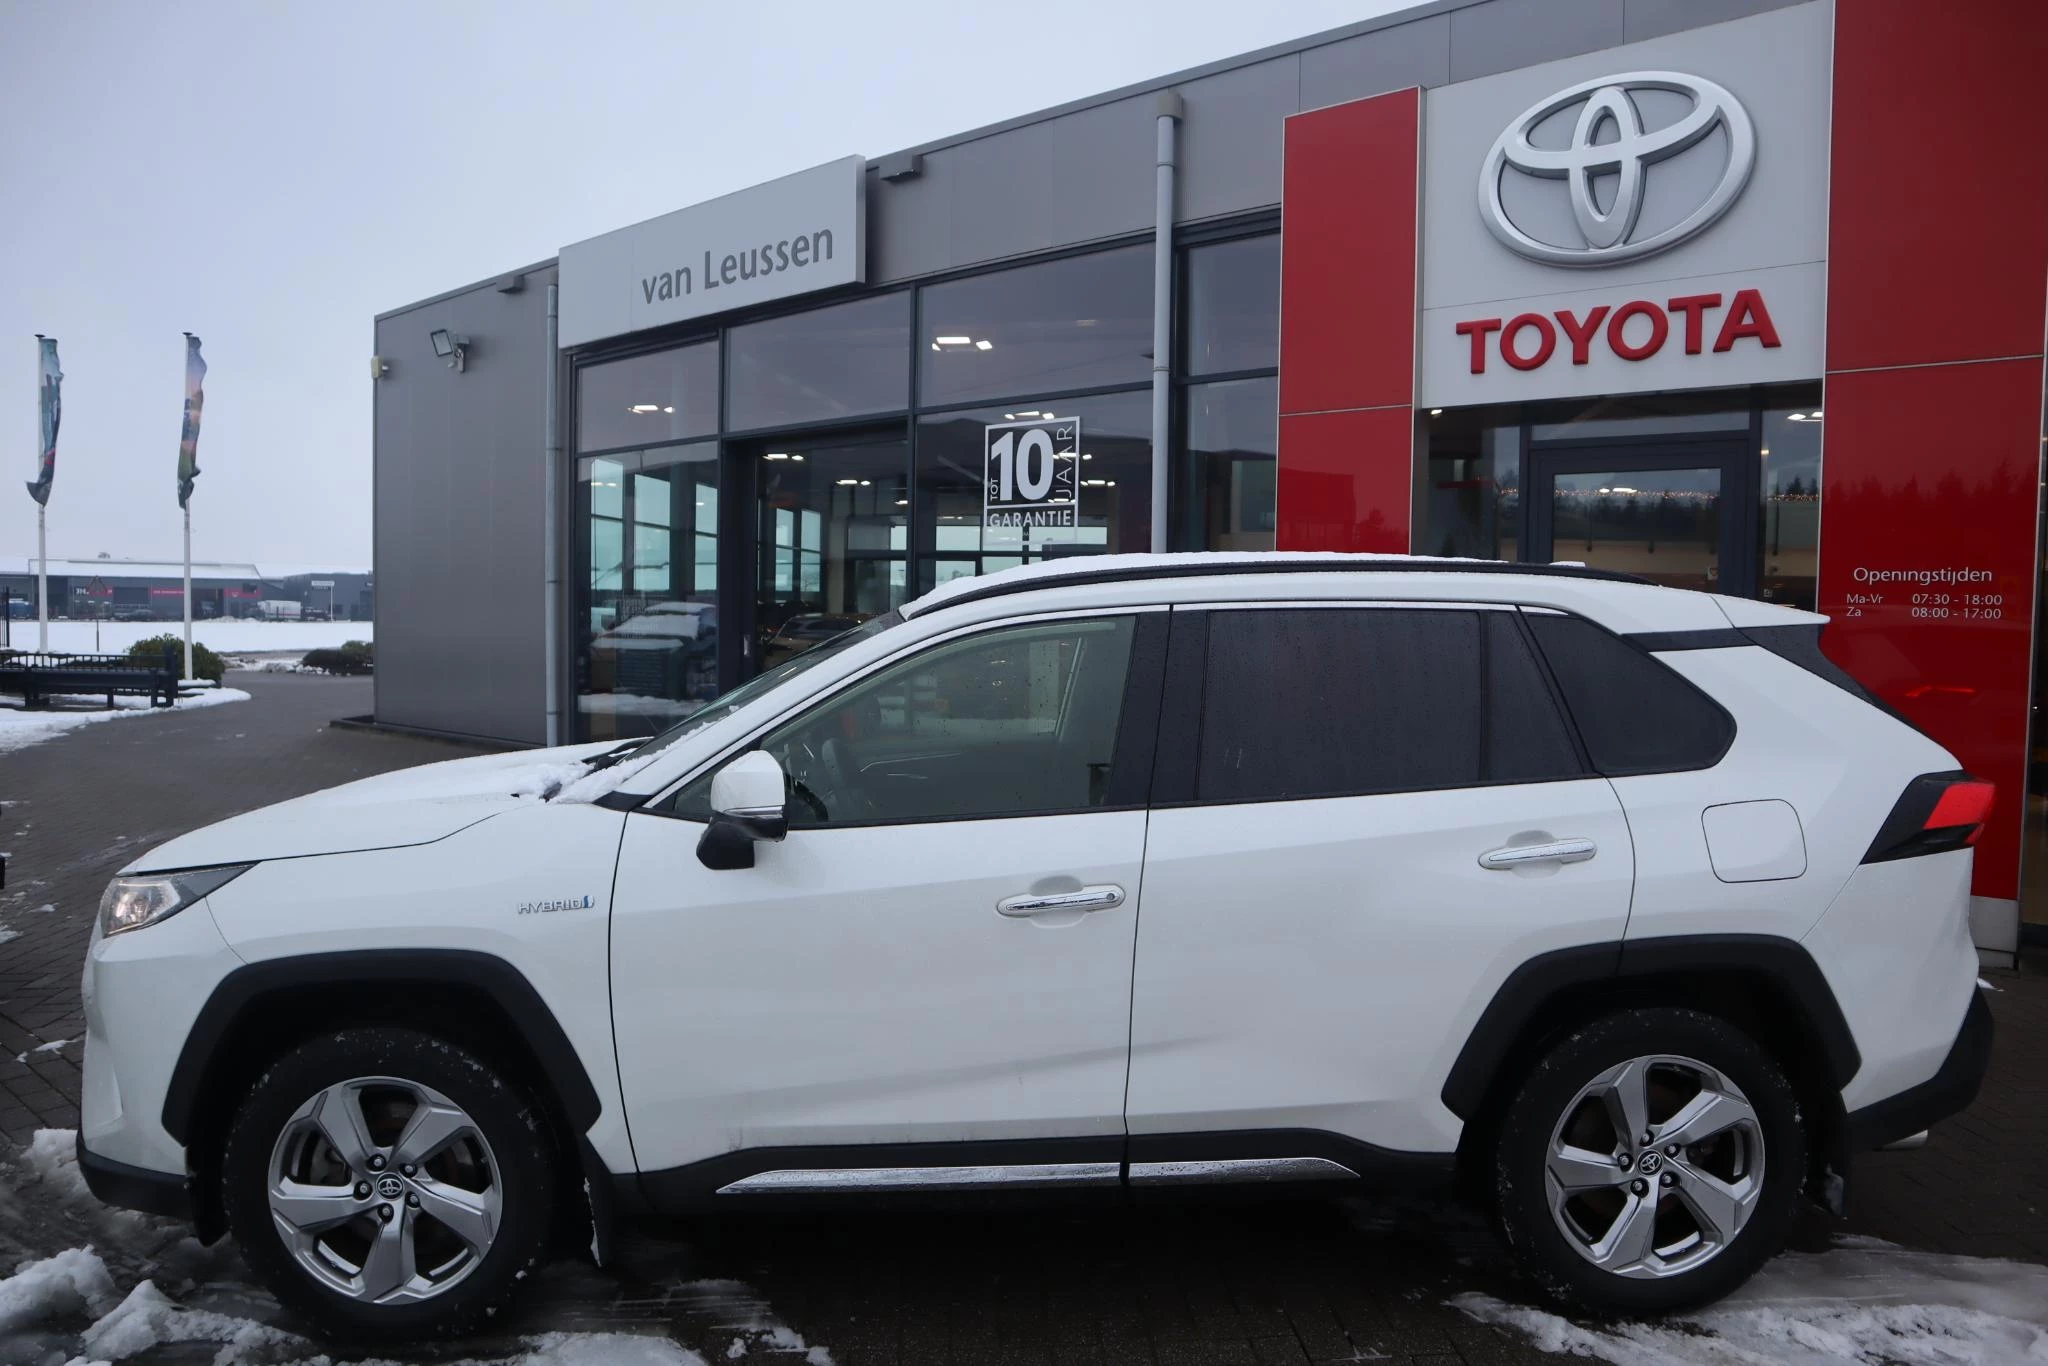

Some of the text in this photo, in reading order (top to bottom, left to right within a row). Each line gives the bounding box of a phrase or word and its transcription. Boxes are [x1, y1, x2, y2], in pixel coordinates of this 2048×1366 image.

[641, 228, 833, 304] van Leussen
[1456, 289, 1782, 375] TOYOTA
[990, 428, 1054, 501] 10
[1055, 425, 1073, 499] JAAR
[990, 477, 999, 501] TOT
[989, 510, 1072, 527] GARANTIE
[1853, 567, 1993, 586] Openingstijden
[1846, 594, 1884, 604] Ma-Vr
[1912, 594, 1950, 605] 07:30
[1964, 594, 2003, 606] 18:00
[1846, 606, 1862, 617] Za
[1911, 608, 1949, 618] 08:00
[1964, 608, 2002, 619] 17:00
[518, 899, 583, 914] HYBRID
